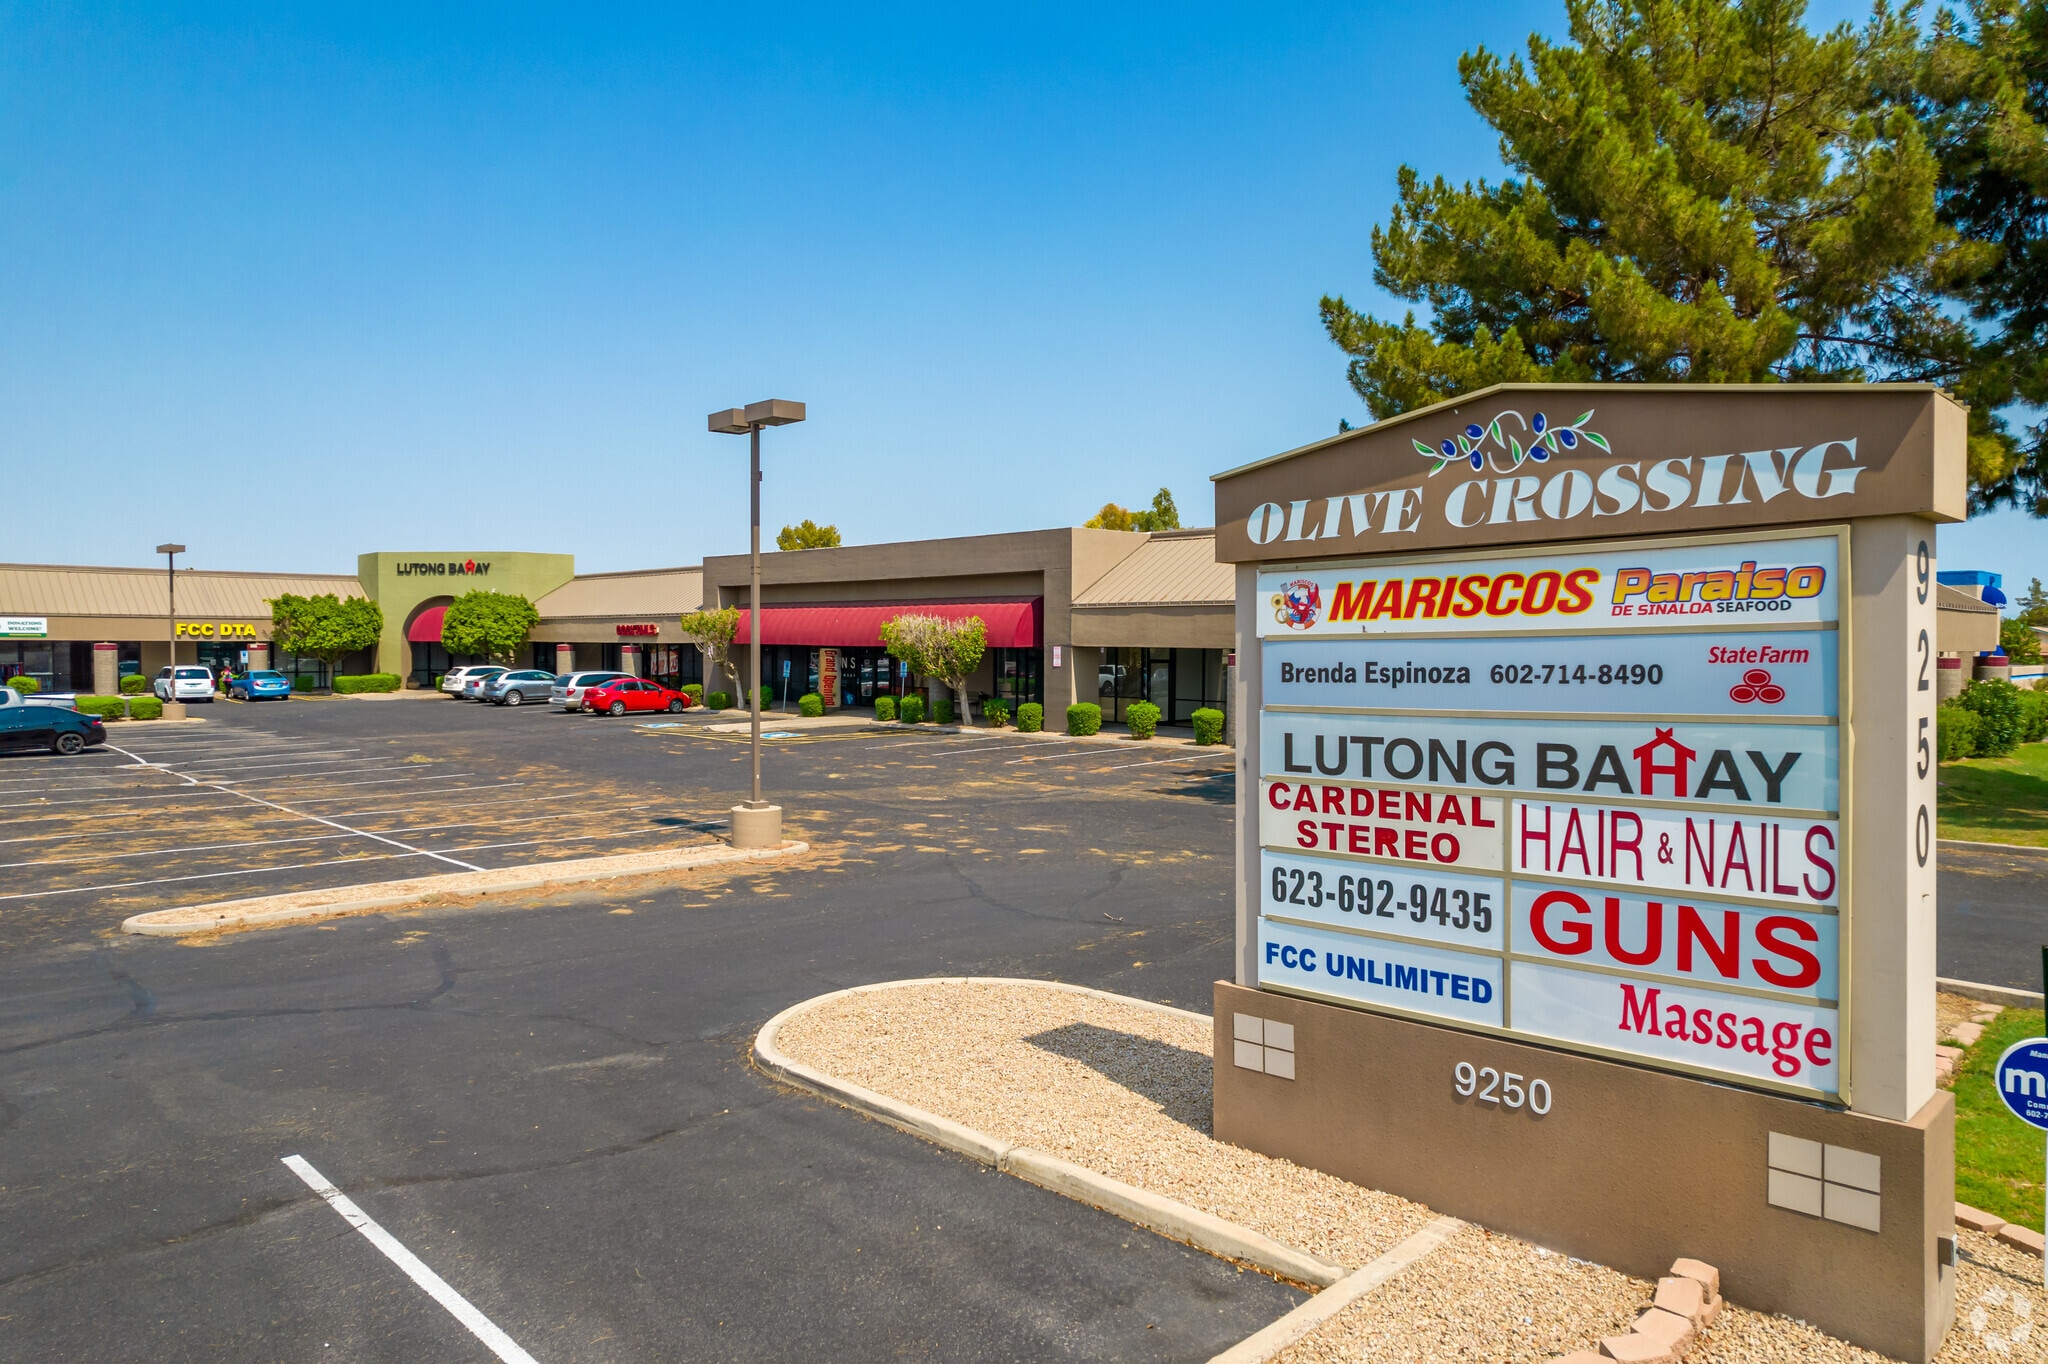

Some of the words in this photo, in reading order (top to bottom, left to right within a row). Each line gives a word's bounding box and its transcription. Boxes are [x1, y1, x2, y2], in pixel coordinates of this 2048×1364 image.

[1246, 486, 1424, 546] OLIVE
[1444, 437, 1867, 528] CROSSING
[397, 563, 445, 576] LUTONG
[448, 559, 490, 576] BAHAY
[1327, 567, 1601, 623] MARISCOS
[1612, 561, 1827, 605] Paraiso
[176, 623, 214, 636] FCC
[220, 623, 256, 636] DTA
[1611, 605, 1633, 616] DE
[1637, 602, 1713, 616] SINALOA
[1716, 600, 1792, 613] SEAFOOD
[1281, 661, 1357, 685] Brenda
[1365, 662, 1471, 690] Espinoza
[1490, 664, 1663, 686] 602-714-8490
[1708, 646, 1757, 663] State
[1759, 646, 1809, 663] Farm
[1284, 732, 1515, 786] LUTONG
[1537, 727, 1802, 803] BAHAY
[1268, 782, 1496, 829] CARDENAL
[1297, 820, 1460, 863] STEREO
[1521, 805, 1643, 881] HAIR
[1657, 833, 1674, 865] &
[1686, 818, 1836, 900] NAILS
[1271, 867, 1493, 933] 623-692-9435
[1530, 890, 1821, 989] GUNS
[1266, 943, 1316, 973] FCC
[1326, 954, 1493, 1004] UNLIMITED
[1619, 984, 1832, 1078] Massage
[1454, 1061, 1552, 1116] 9250
[2005, 1068, 2048, 1098] m
[2026, 1109, 2048, 1118] 602-7
